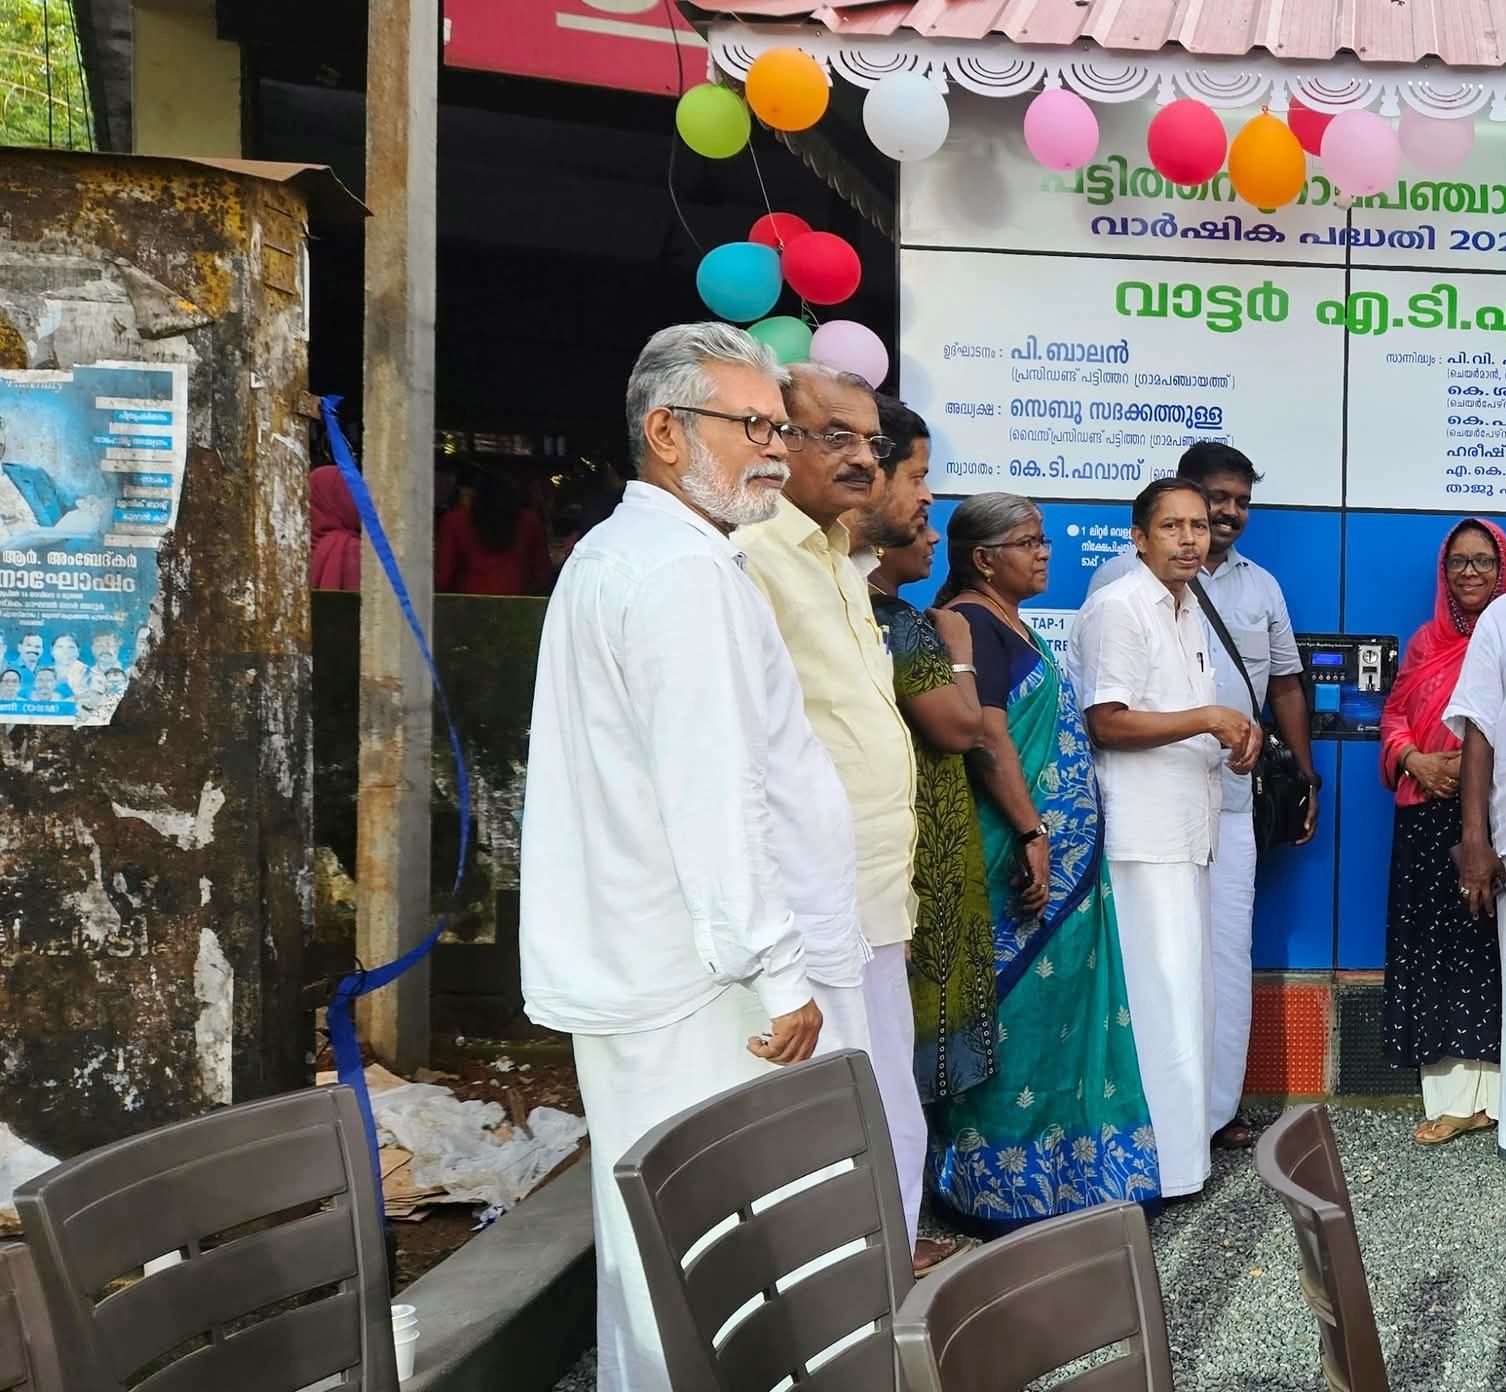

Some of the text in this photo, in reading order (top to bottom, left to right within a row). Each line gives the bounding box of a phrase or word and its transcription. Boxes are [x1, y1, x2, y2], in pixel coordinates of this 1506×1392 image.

[1091, 212, 1286, 244] വാർഷിക
[1115, 280, 1290, 333] വാട്ടർ
[1031, 617, 1064, 629] TAP-1
